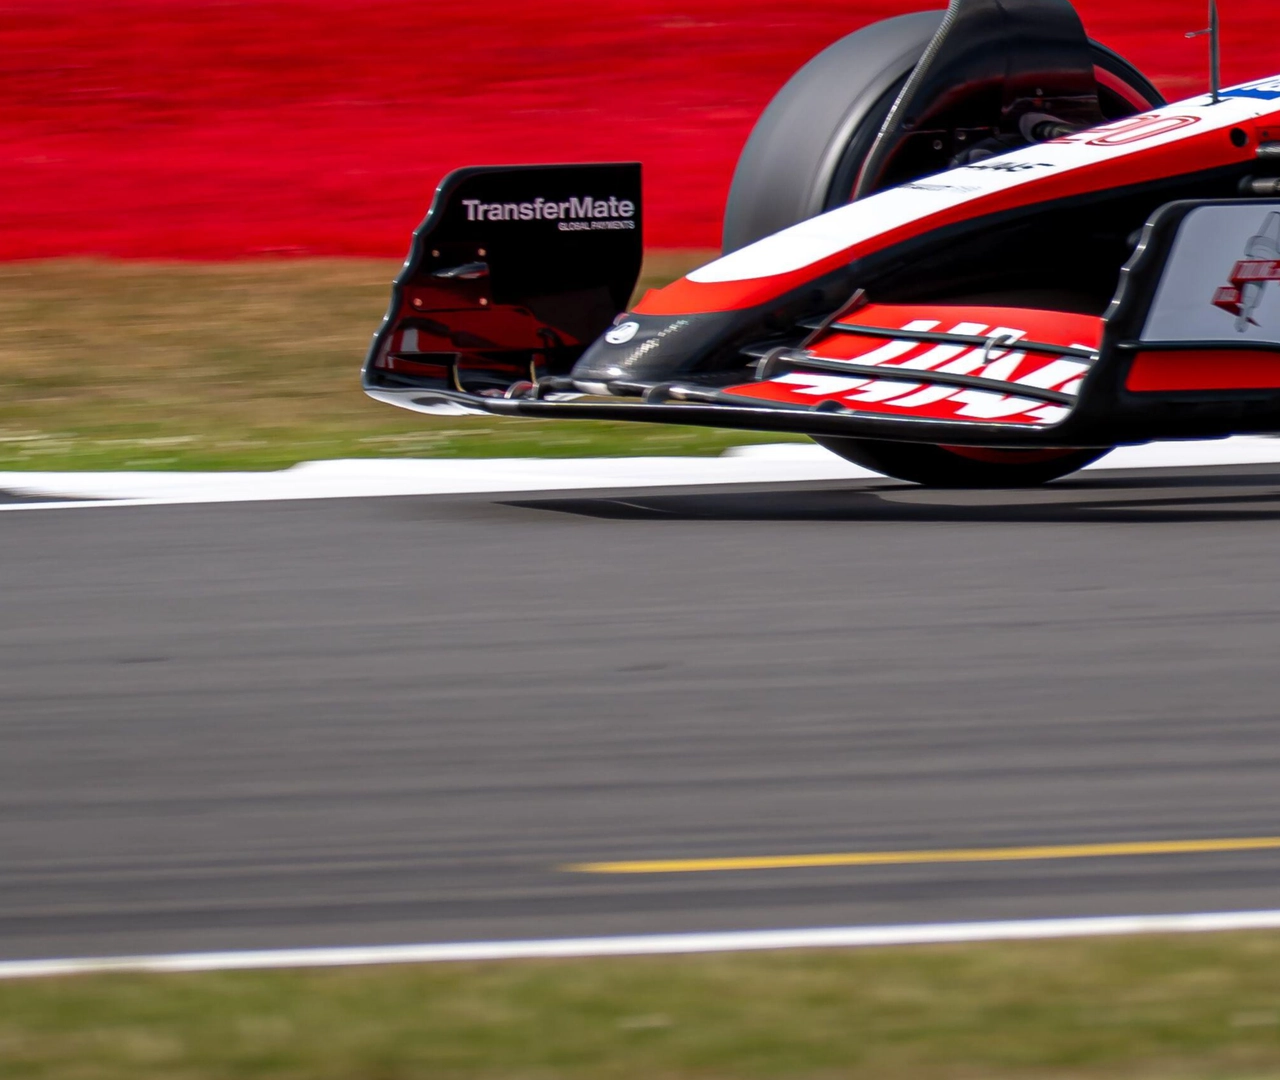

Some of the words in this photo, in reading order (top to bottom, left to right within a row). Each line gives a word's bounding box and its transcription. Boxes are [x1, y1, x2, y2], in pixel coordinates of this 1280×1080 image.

[462, 196, 635, 220] TransferMate
[558, 221, 590, 231] GLOBAL
[591, 220, 635, 230] PAYMENTS
